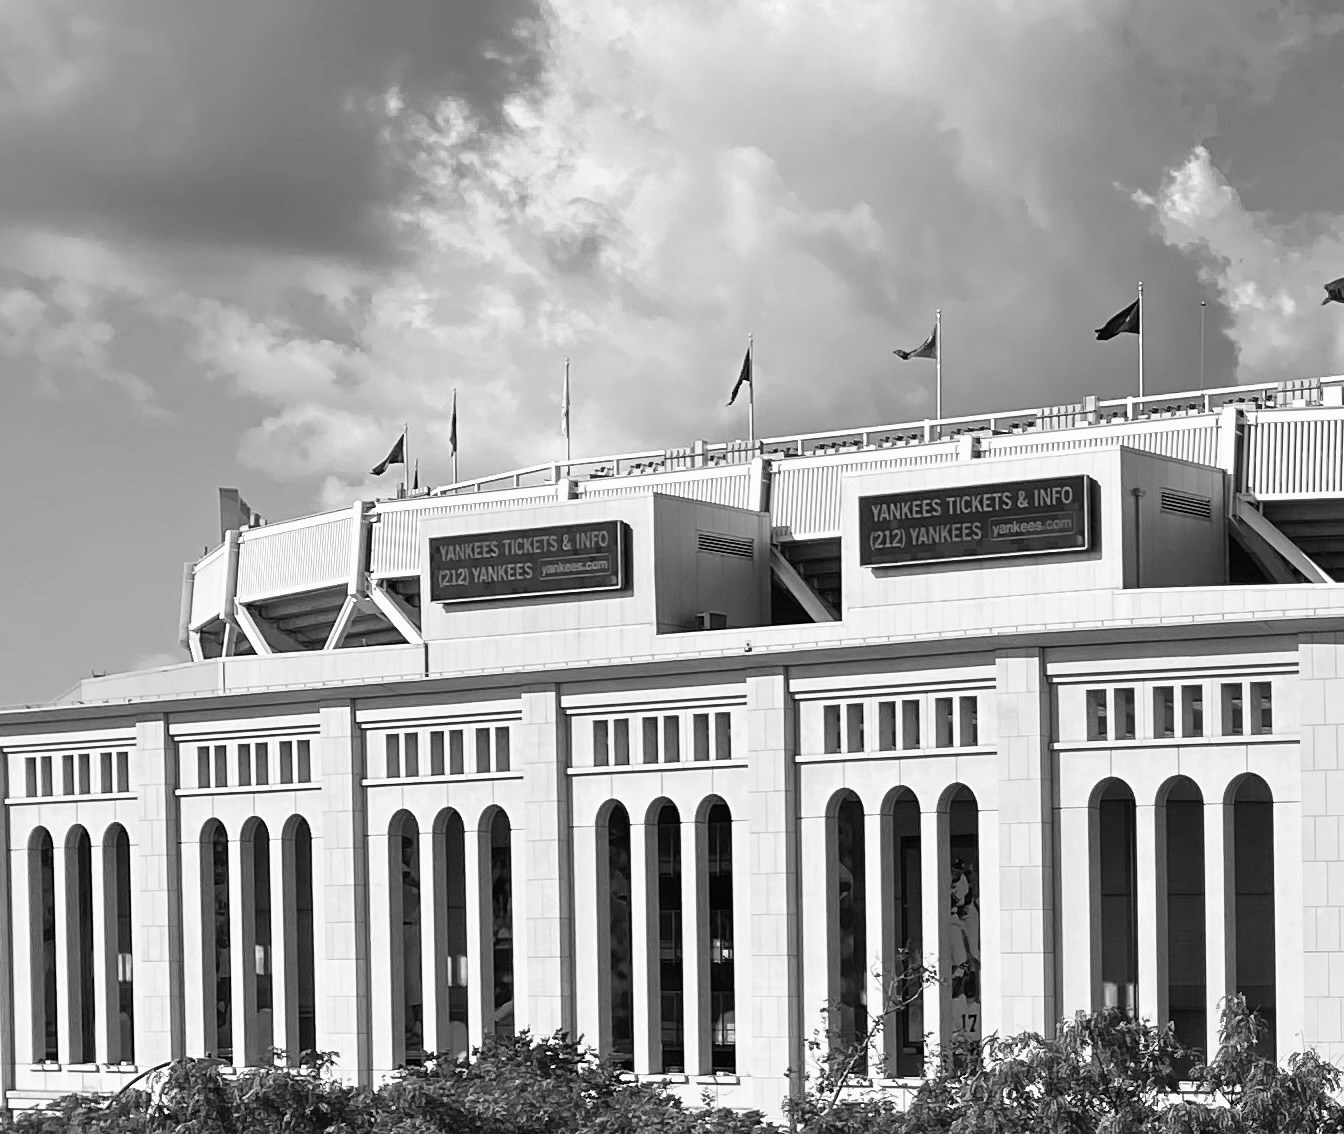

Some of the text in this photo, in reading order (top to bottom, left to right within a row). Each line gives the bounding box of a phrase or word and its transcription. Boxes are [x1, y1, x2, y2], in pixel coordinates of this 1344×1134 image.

[871, 486, 1073, 523] YANKEES TICKETS & INFO
[869, 522, 982, 551] (212) YANKEES
[991, 518, 1072, 538] yankees.com
[439, 530, 609, 562] YANKEES TICKETS & INFO
[438, 562, 533, 588] (212) YANKEES
[541, 559, 608, 577] yankees.com
